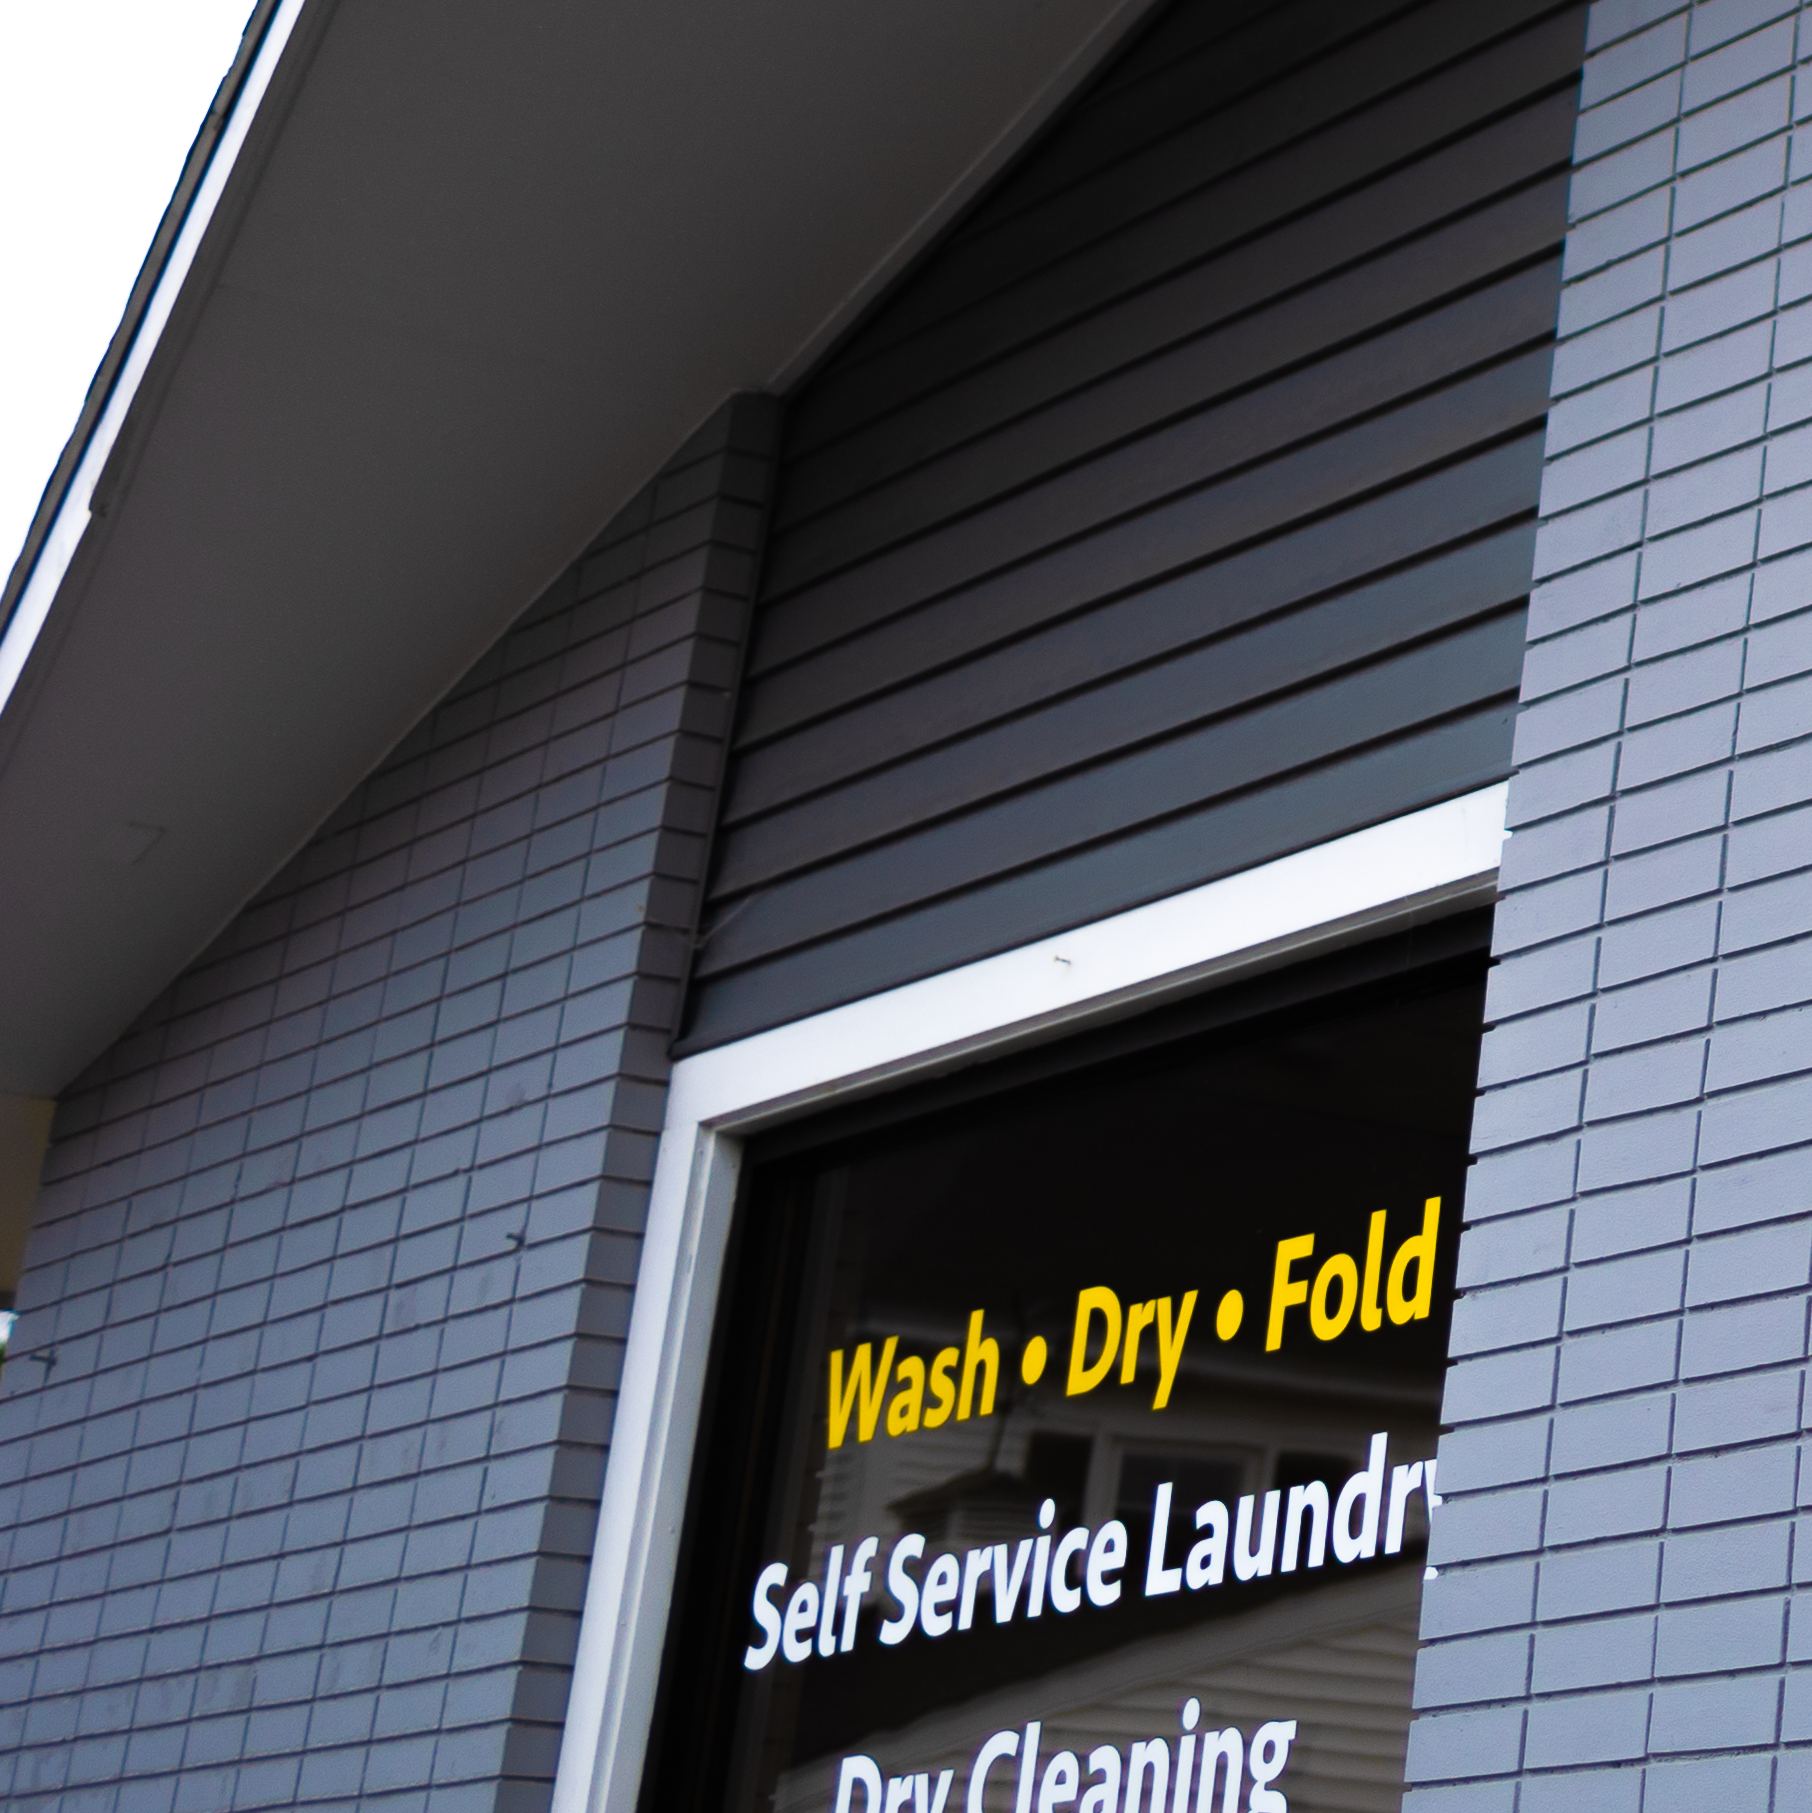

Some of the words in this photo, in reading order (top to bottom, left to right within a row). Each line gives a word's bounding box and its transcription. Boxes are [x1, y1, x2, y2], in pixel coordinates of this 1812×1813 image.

[827, 1307, 1000, 1450] Wash
[1064, 1285, 1199, 1411] Dry
[1264, 1196, 1442, 1352] Fold
[743, 1536, 878, 1671] Self
[879, 1498, 1128, 1646] Service
[966, 1697, 1298, 1813] Cleaning
